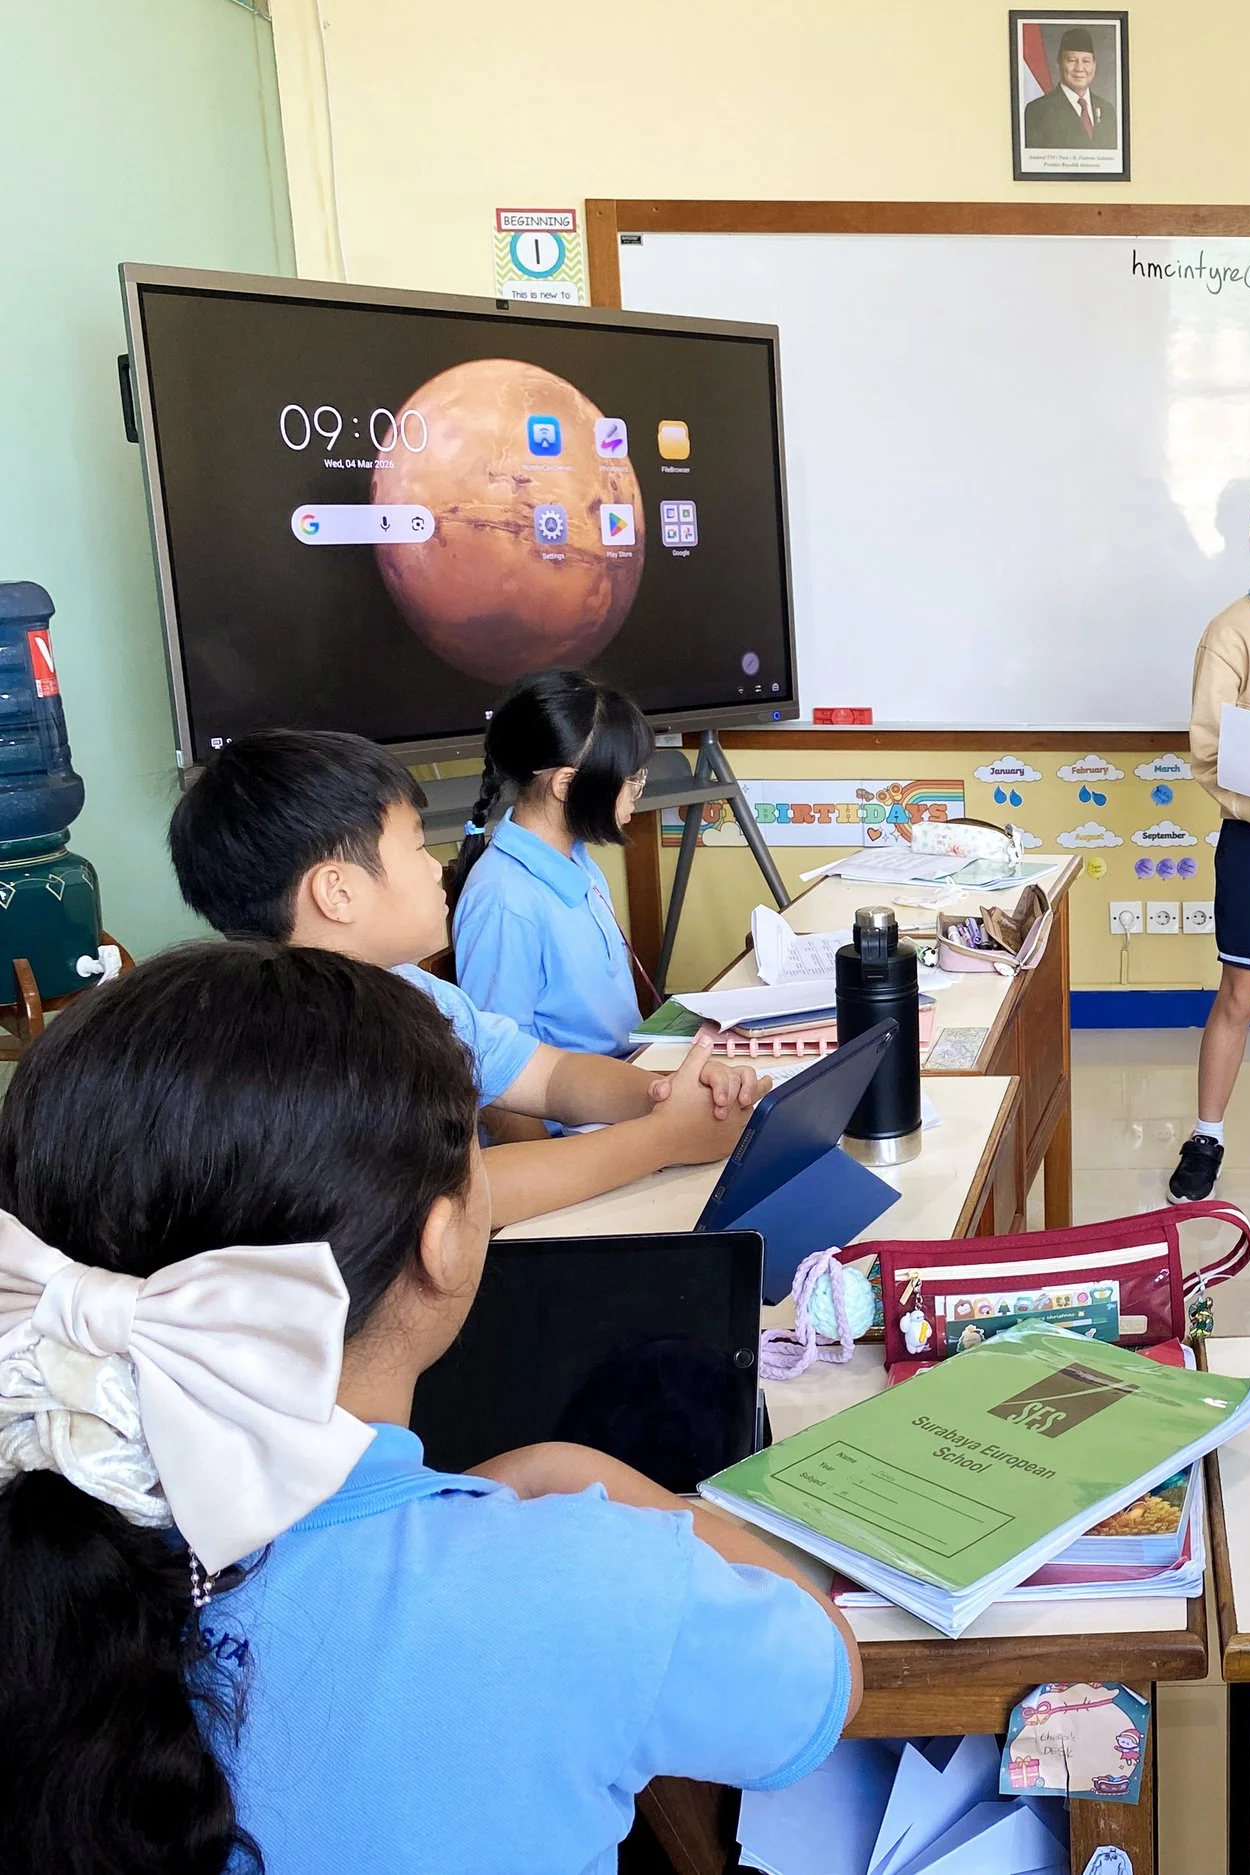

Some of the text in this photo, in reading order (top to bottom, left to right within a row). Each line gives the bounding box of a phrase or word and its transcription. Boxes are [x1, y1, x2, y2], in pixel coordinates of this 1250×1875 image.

[503, 215, 571, 227] BEGINNING
[511, 290, 571, 300] This is new to
[280, 404, 428, 453] 09:00
[323, 458, 395, 470] Wed, 04 Mar 2026
[542, 552, 565, 561] Settings
[672, 549, 690, 558] Google
[989, 766, 1025, 777] January
[1071, 765, 1109, 777] February
[1154, 764, 1181, 774] March
[755, 803, 948, 824] BIRTHDAYS
[1074, 832, 1105, 843] August
[1142, 831, 1186, 842] September
[911, 1415, 1057, 1480] Surabaya European
[836, 1451, 858, 1464] Name
[932, 1445, 993, 1474] School
[819, 1461, 836, 1472] Year
[799, 1471, 827, 1487] Subject
